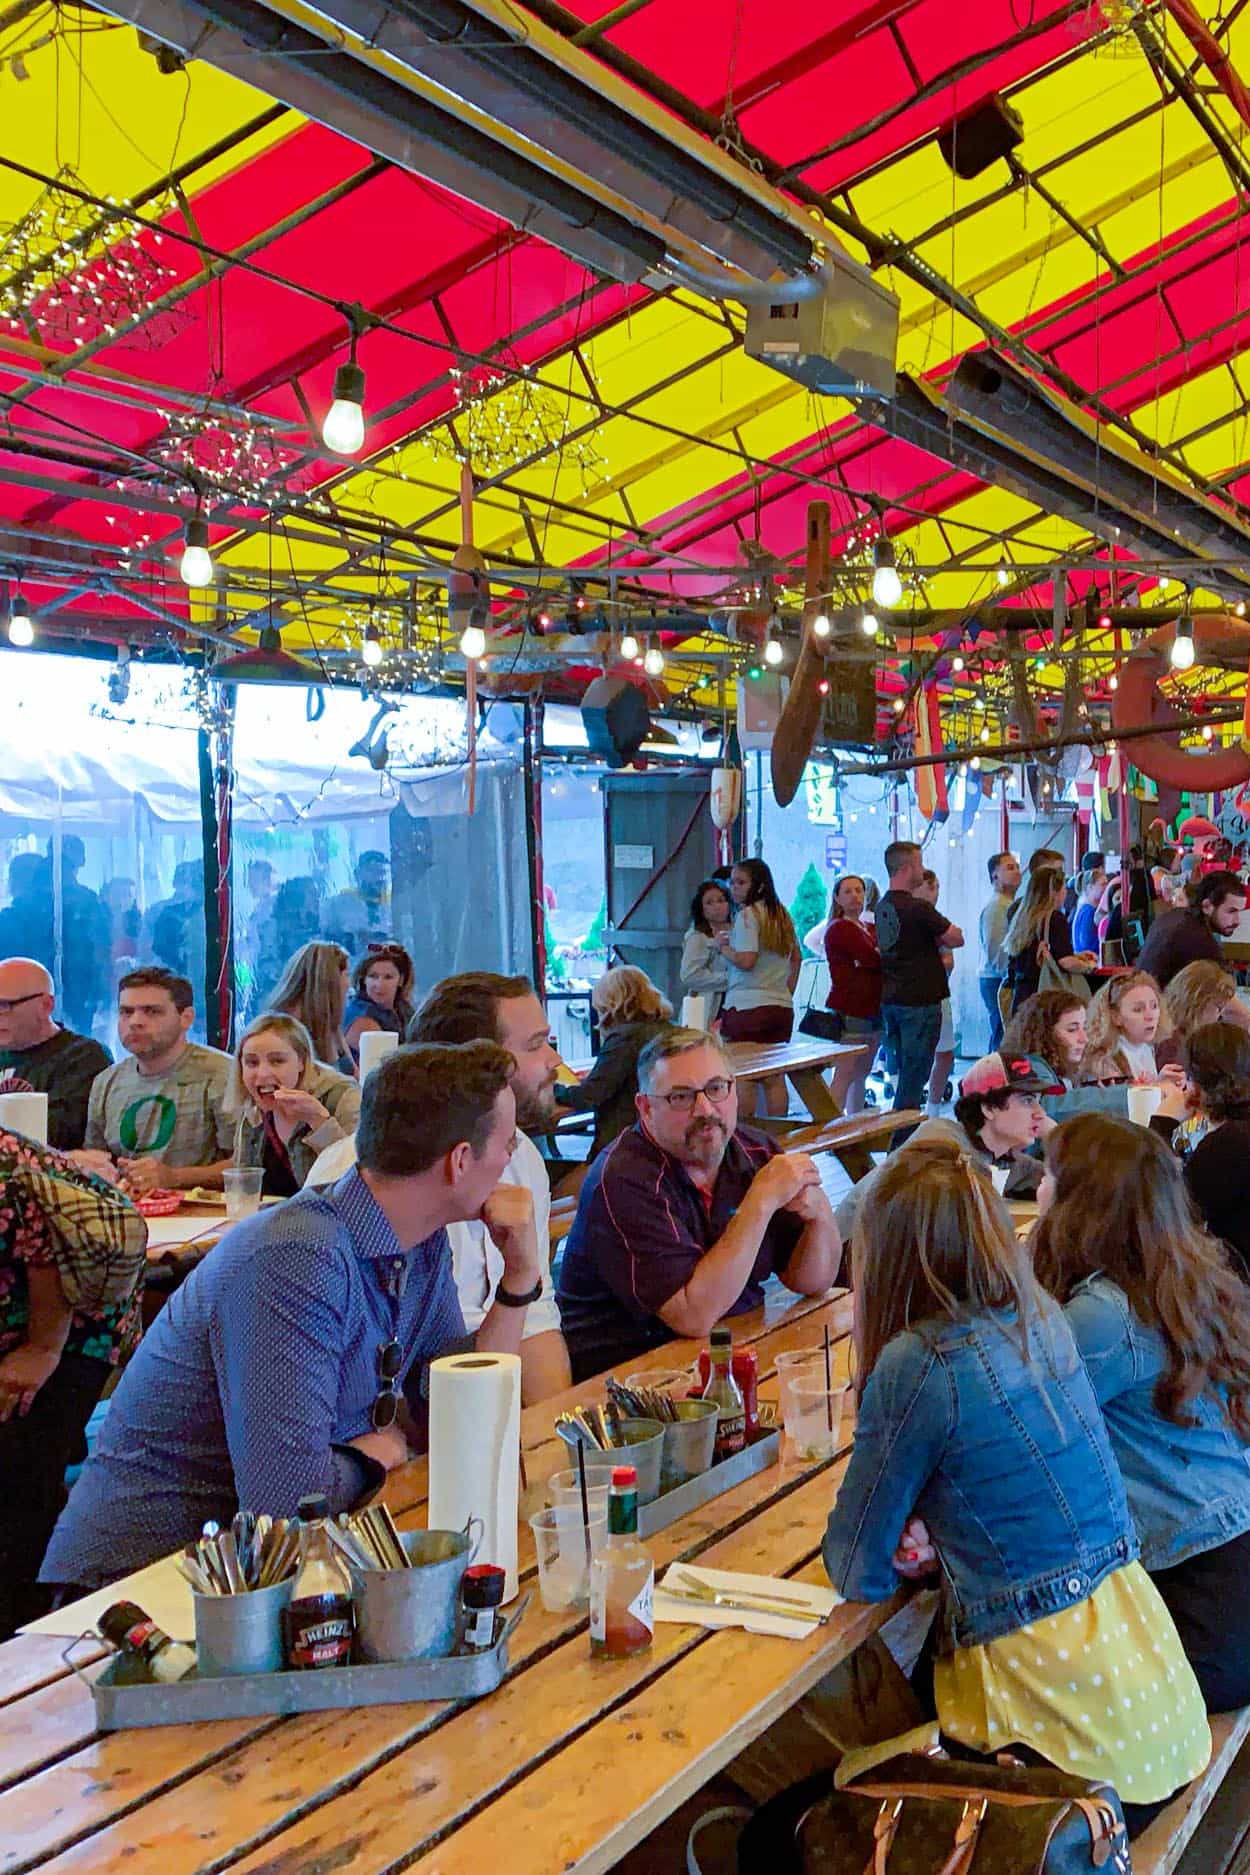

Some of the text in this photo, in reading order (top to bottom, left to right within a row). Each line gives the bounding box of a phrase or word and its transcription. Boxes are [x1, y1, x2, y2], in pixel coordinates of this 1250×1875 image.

[120, 1095, 177, 1153] O
[307, 1622, 345, 1643] HEINZ
[312, 1645, 339, 1660] MALT
